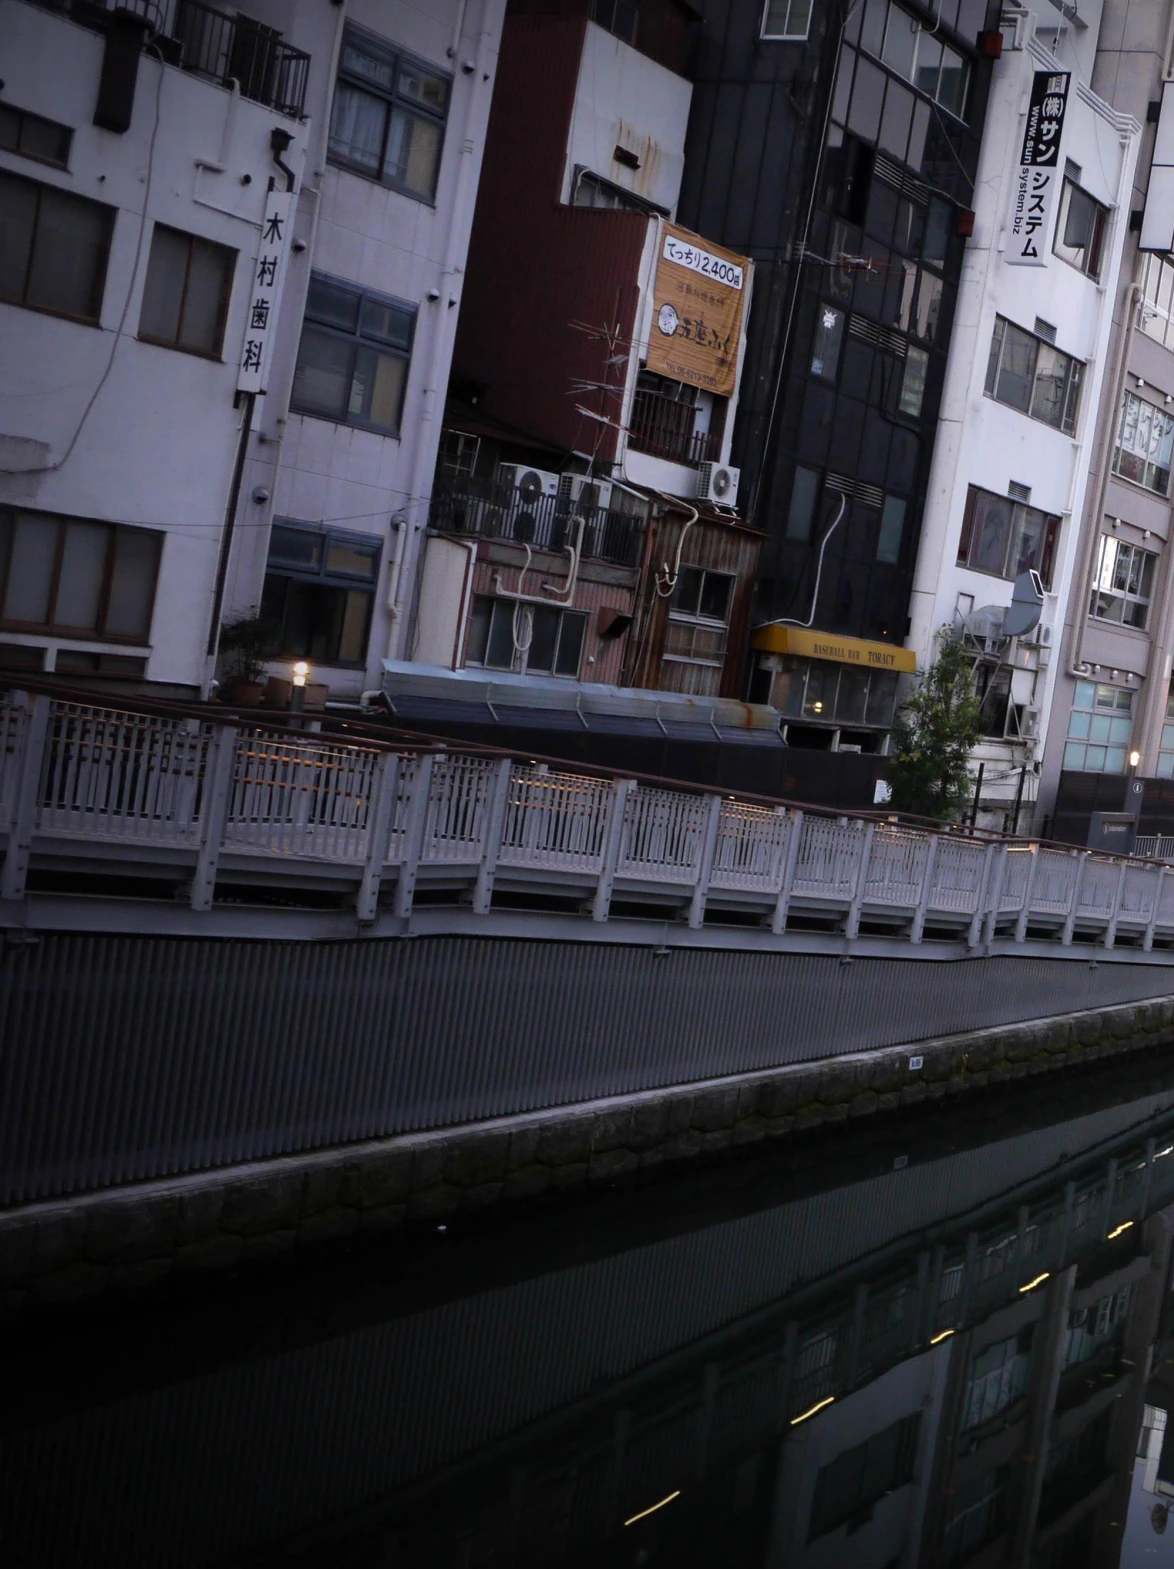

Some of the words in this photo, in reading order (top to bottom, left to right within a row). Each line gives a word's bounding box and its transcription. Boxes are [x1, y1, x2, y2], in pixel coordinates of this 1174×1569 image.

[242, 211, 284, 373] 木村歯科
[813, 644, 845, 658] BASEBALL
[847, 649, 860, 660] BAR
[867, 651, 896, 666] TORACY
